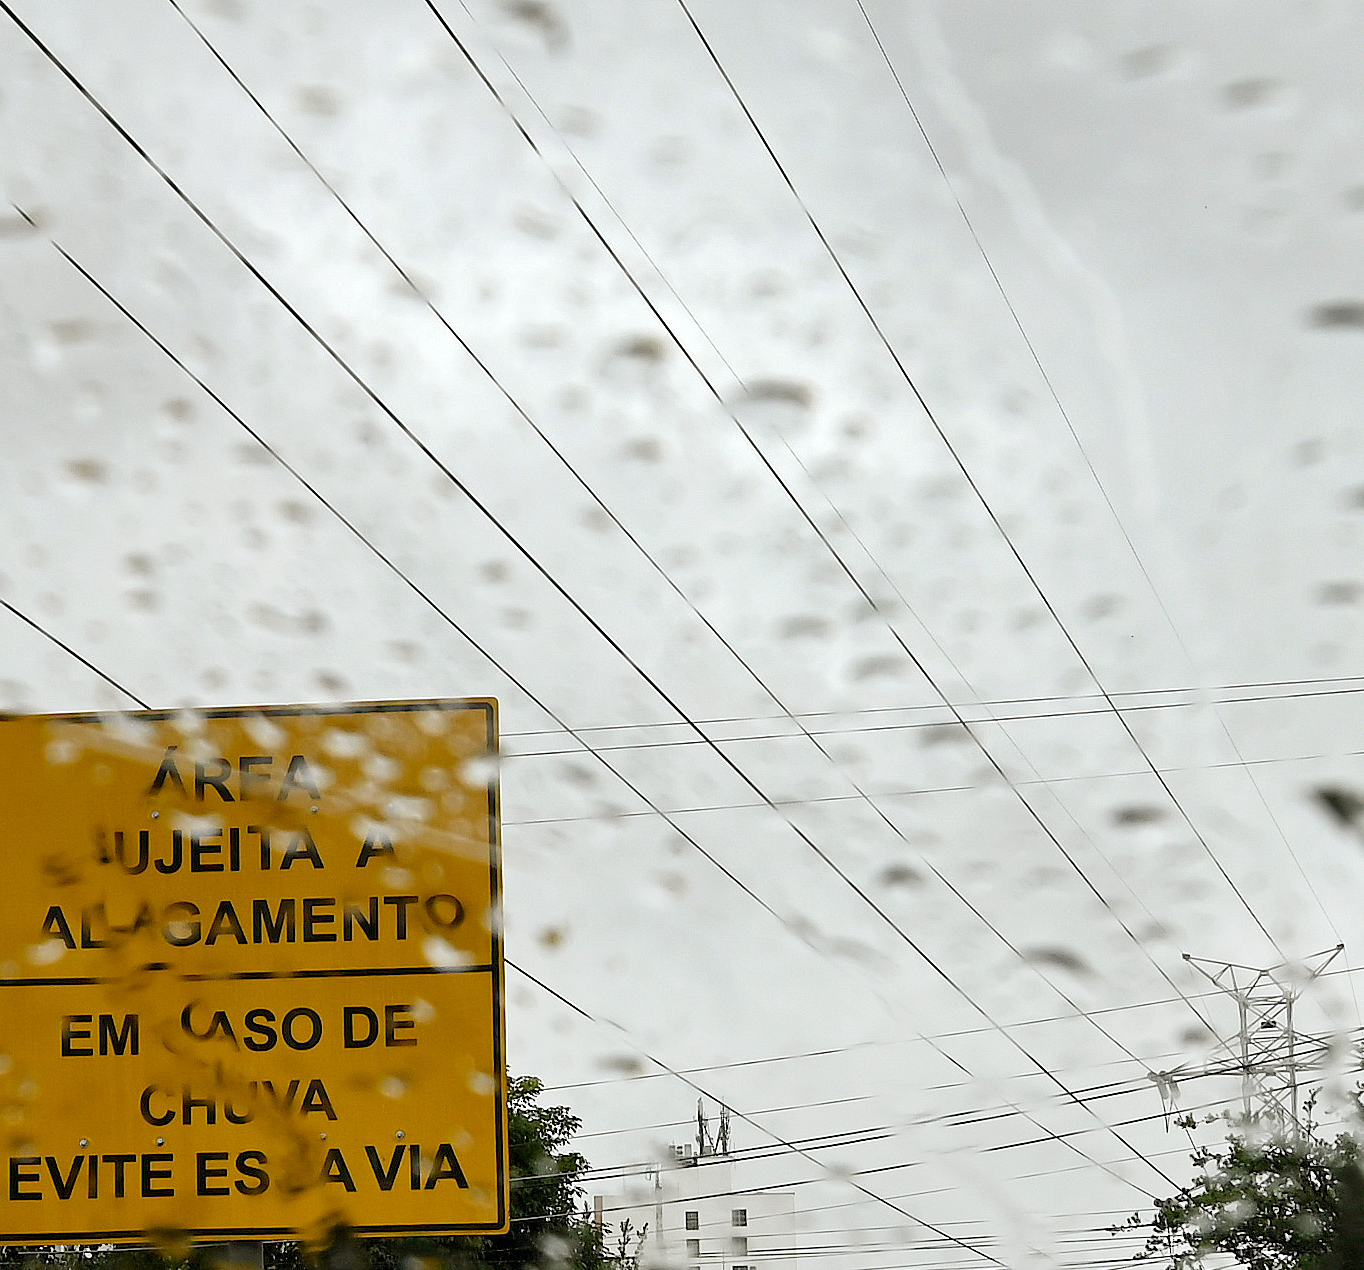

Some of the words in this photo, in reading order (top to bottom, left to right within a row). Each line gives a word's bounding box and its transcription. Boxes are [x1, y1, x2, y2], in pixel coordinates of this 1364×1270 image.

[148, 746, 321, 801] ÁREA
[99, 826, 325, 875] UJEITA
[356, 828, 397, 869] A
[61, 1014, 139, 1057] EM
[180, 1000, 323, 1052] CASO
[343, 1005, 418, 1049] DE
[140, 1078, 338, 1127] CHUVA
[9, 1153, 175, 1201] EVITE
[196, 1148, 357, 1197] ESA
[364, 1143, 469, 1191] VIA
